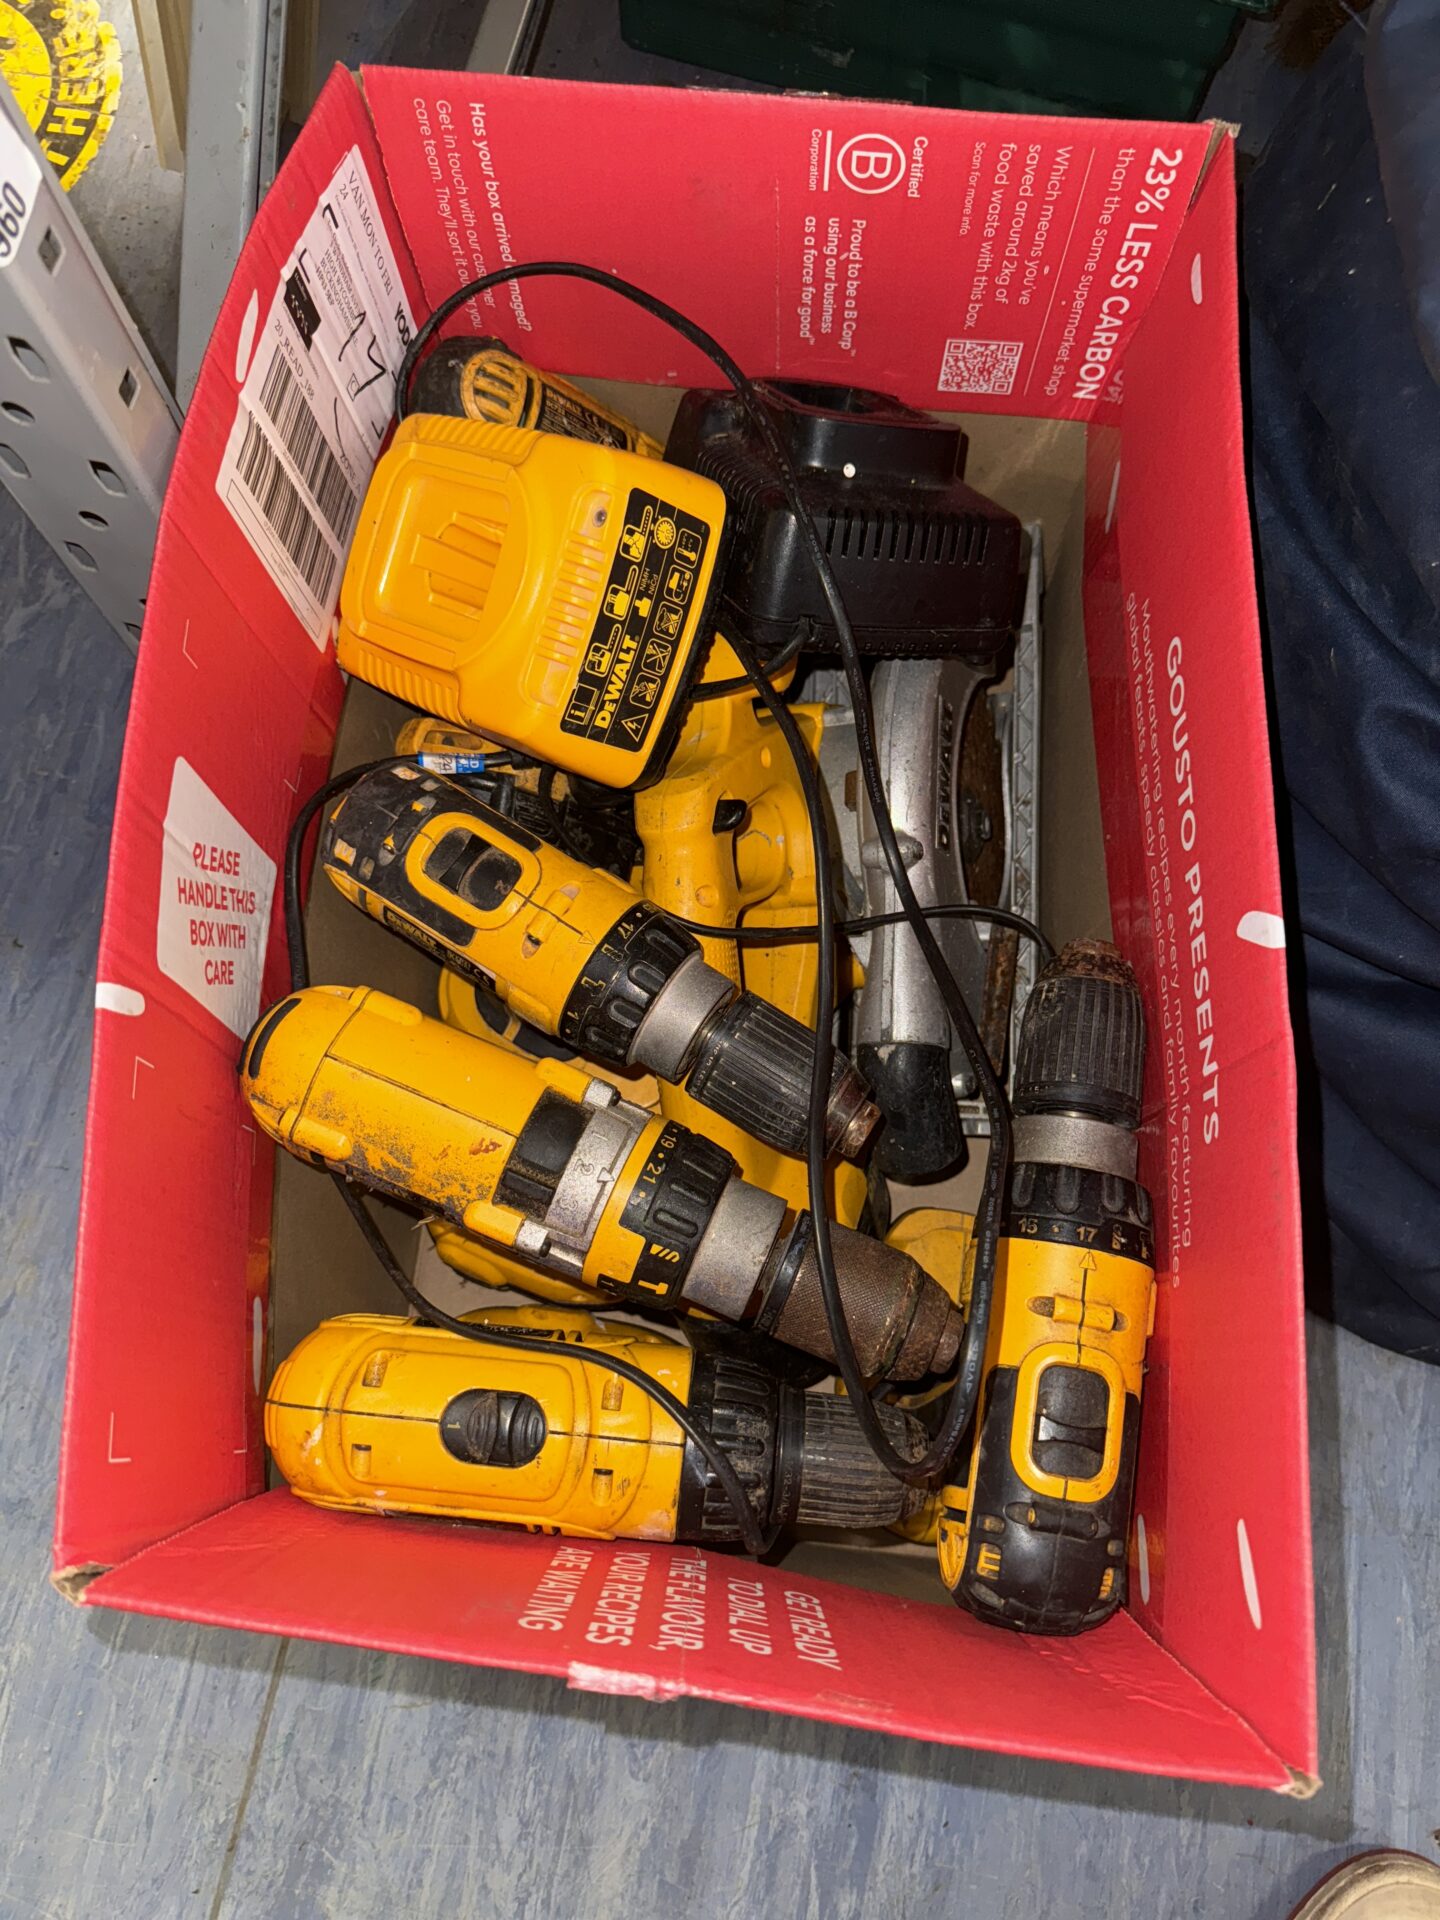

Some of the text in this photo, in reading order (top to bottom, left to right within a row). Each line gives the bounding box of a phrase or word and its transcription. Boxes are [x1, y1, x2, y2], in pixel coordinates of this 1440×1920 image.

[413, 97, 432, 136] care
[423, 139, 443, 182] team.
[808, 128, 823, 191] Corporation
[851, 150, 893, 180] B
[907, 136, 929, 198] Certified
[1044, 146, 1073, 201] Which
[435, 99, 496, 308] Get in touch with our custmer
[959, 141, 987, 235] Scan for more info.
[349, 170, 394, 296] VAN MON TO FRI
[446, 230, 465, 256] sort
[469, 102, 532, 331] Has your box arrived maged?
[803, 235, 815, 246] a
[804, 215, 816, 233] as
[848, 219, 867, 261] Proud
[963, 142, 1018, 330] food waste with this box.
[994, 144, 1041, 305] saved around 2kg of
[1030, 204, 1054, 257] means
[454, 257, 468, 267] it
[802, 248, 818, 284] force
[821, 217, 842, 333] using our business
[845, 279, 861, 297] be
[847, 262, 862, 278] to
[1043, 147, 1136, 396] than the same supermarket shop
[1073, 148, 1183, 399] 23% LESS CARBON
[464, 307, 482, 328] you.
[801, 286, 816, 306] for
[843, 310, 858, 319] B
[844, 299, 856, 308] a
[394, 301, 412, 347] YOD
[1126, 592, 1142, 671] global
[594, 633, 637, 730] DEWALT
[1140, 763, 1156, 857] speedy
[193, 842, 240, 876] PLEASE
[177, 877, 256, 914] HANDLE THIS
[1150, 862, 1166, 961] classics
[1167, 637, 1219, 1143] GOUSTO PRESENTS
[190, 919, 246, 949] BOX WITH
[1142, 599, 1194, 1248] Mouthwatering recipes every month featuring
[205, 959, 234, 985] CARE
[1160, 974, 1173, 1030] and
[1166, 1036, 1180, 1125] family
[660, 1132, 677, 1150] 19
[643, 1161, 662, 1185] 21
[1076, 1225, 1099, 1243] 17
[1170, 1136, 1181, 1288] favourites
[518, 1545, 594, 1632] ARE WAITING
[585, 1552, 651, 1647] YOUR RECIPES
[649, 1557, 707, 1651] THE FLAVOUR,
[727, 1577, 773, 1655] TO DIAL UP
[784, 1590, 843, 1671] GET READY
